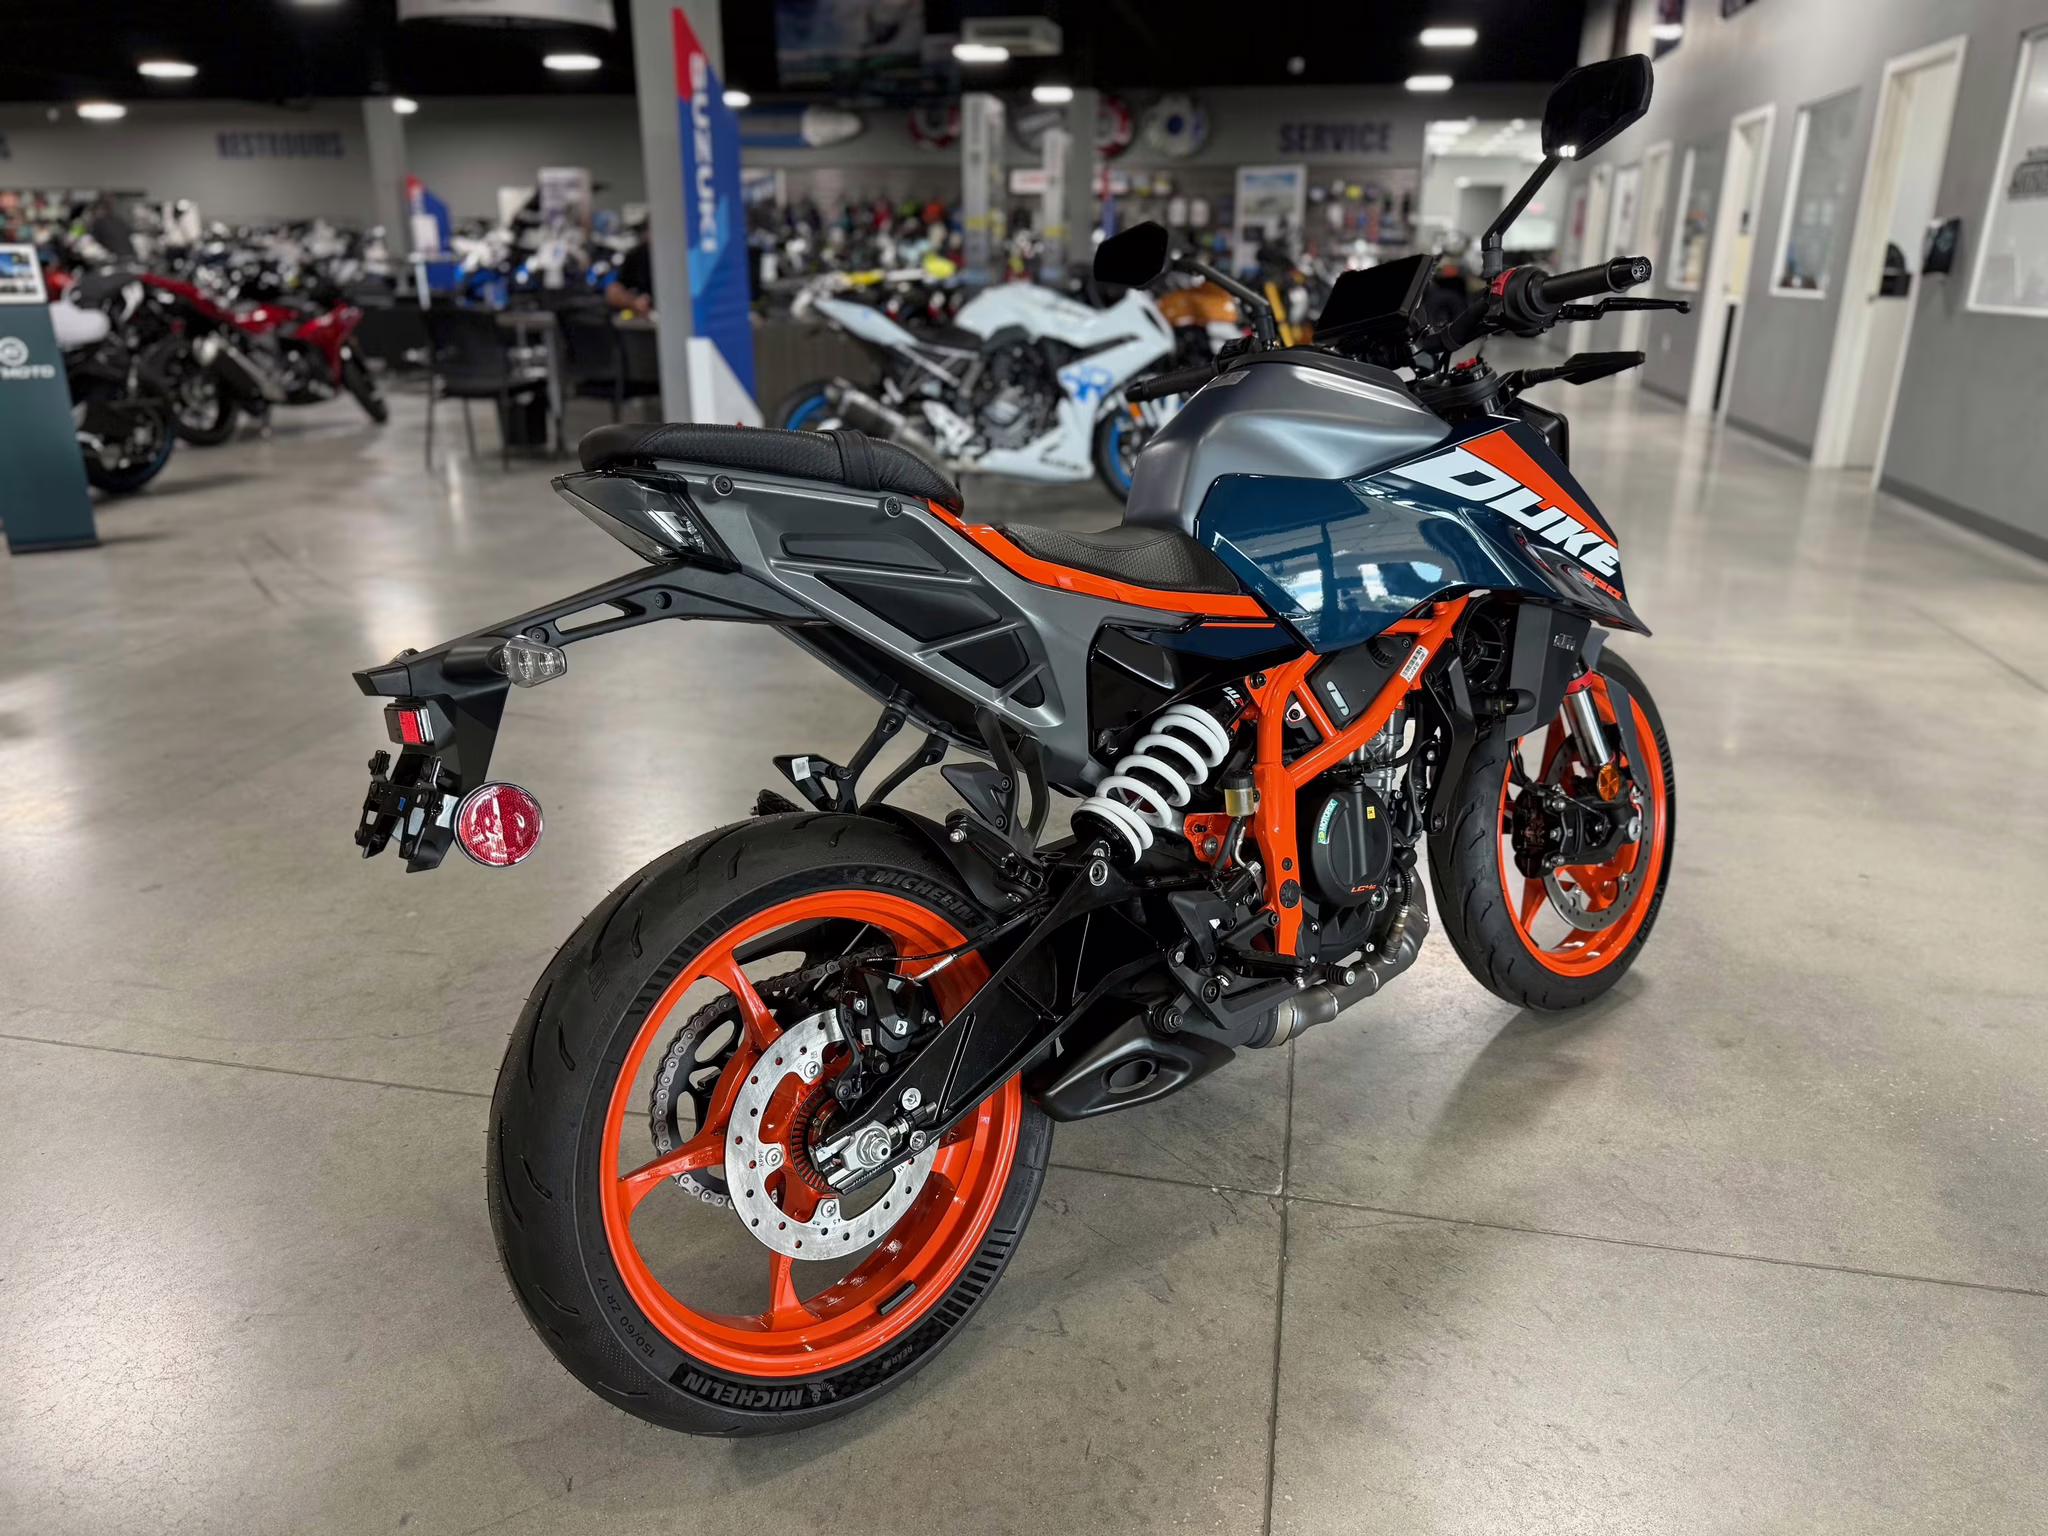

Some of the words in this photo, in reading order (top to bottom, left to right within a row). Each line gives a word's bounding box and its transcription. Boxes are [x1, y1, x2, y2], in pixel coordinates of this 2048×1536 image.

[689, 52, 718, 253] SUZUKI
[1281, 121, 1390, 154] SERVICE
[1389, 446, 1620, 577] DUKE
[1579, 567, 1622, 600] 390
[871, 869, 976, 920] MICHELIN
[598, 1277, 609, 1292] 17
[606, 1294, 622, 1314] ZR
[620, 1316, 656, 1358] 150/60
[891, 1344, 914, 1365] REAR
[682, 1371, 805, 1408] MICHELIN
